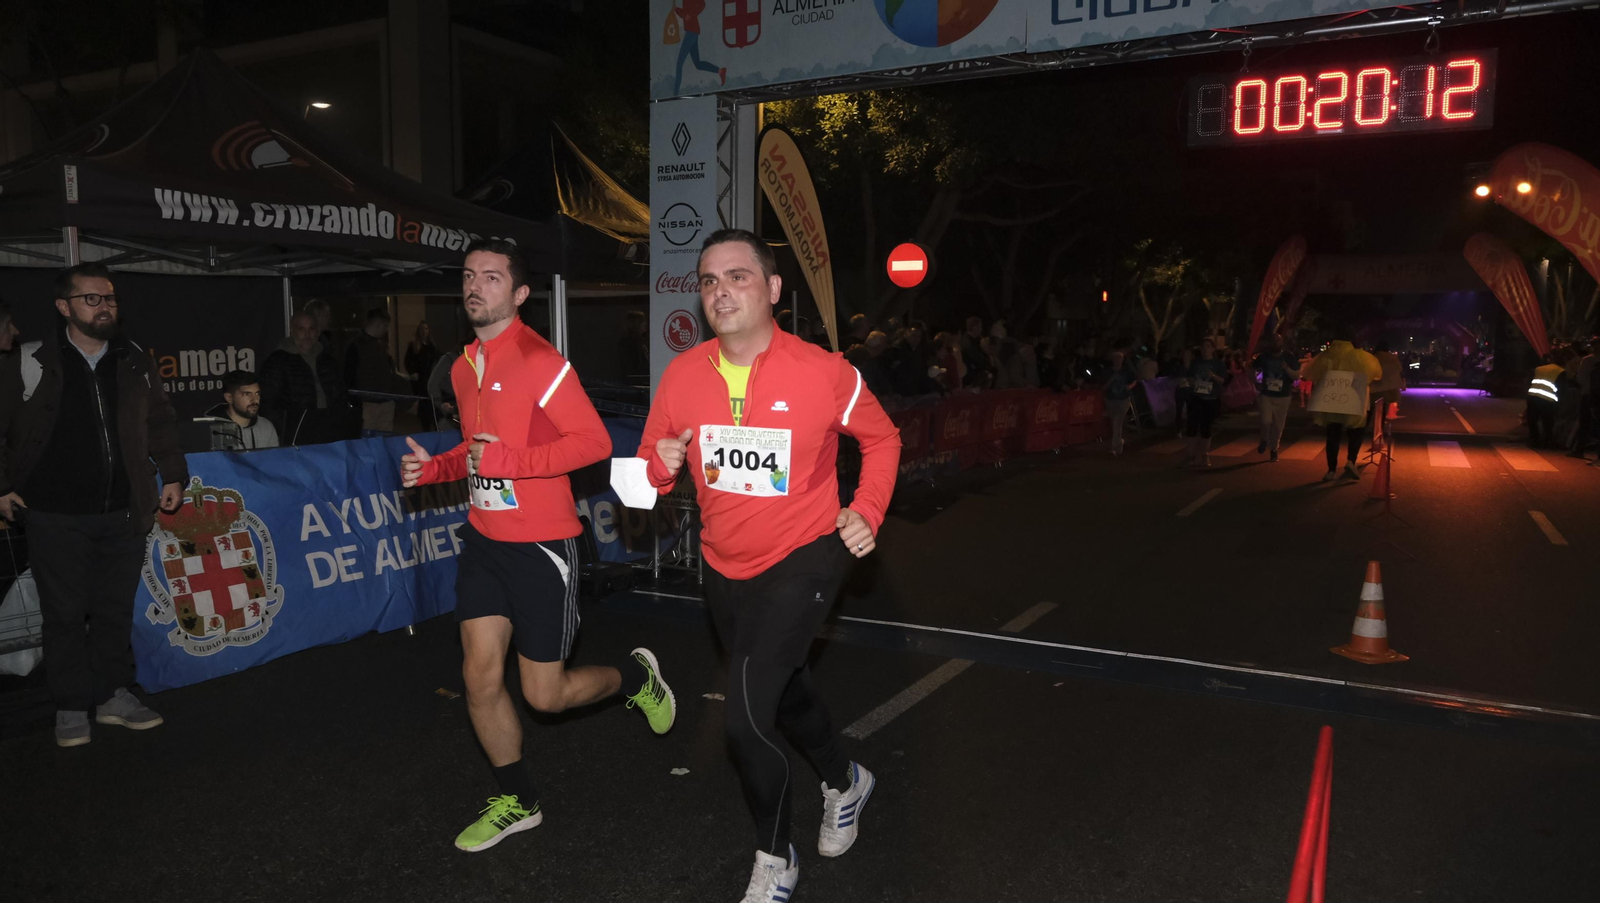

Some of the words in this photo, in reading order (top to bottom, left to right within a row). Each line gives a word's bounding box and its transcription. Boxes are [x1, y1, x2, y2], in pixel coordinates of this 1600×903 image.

[791, 9, 835, 26] CIUDAD
[1234, 59, 1481, 135] 00:20:12
[657, 162, 706, 174] RENAULT
[154, 187, 516, 253] www.cruzandolamet
[658, 219, 703, 229] NISSAN
[655, 270, 701, 294] Coca-Col
[149, 345, 256, 379] ameta
[189, 379, 223, 391] depo
[1322, 392, 1349, 404] ORO
[719, 427, 731, 436] XIV
[732, 428, 746, 437] SAN
[747, 429, 785, 439] SILVESTRE
[719, 435, 744, 445] CIUDAD
[745, 437, 754, 446] DE
[714, 447, 778, 473] 1004
[468, 474, 505, 490] 005
[300, 481, 475, 542] AYUNTAM
[259, 529, 270, 544] POR
[265, 546, 272, 556] LA
[305, 544, 365, 589] DE
[144, 568, 160, 592] NOBLE
[193, 640, 221, 652] CIUDAD
